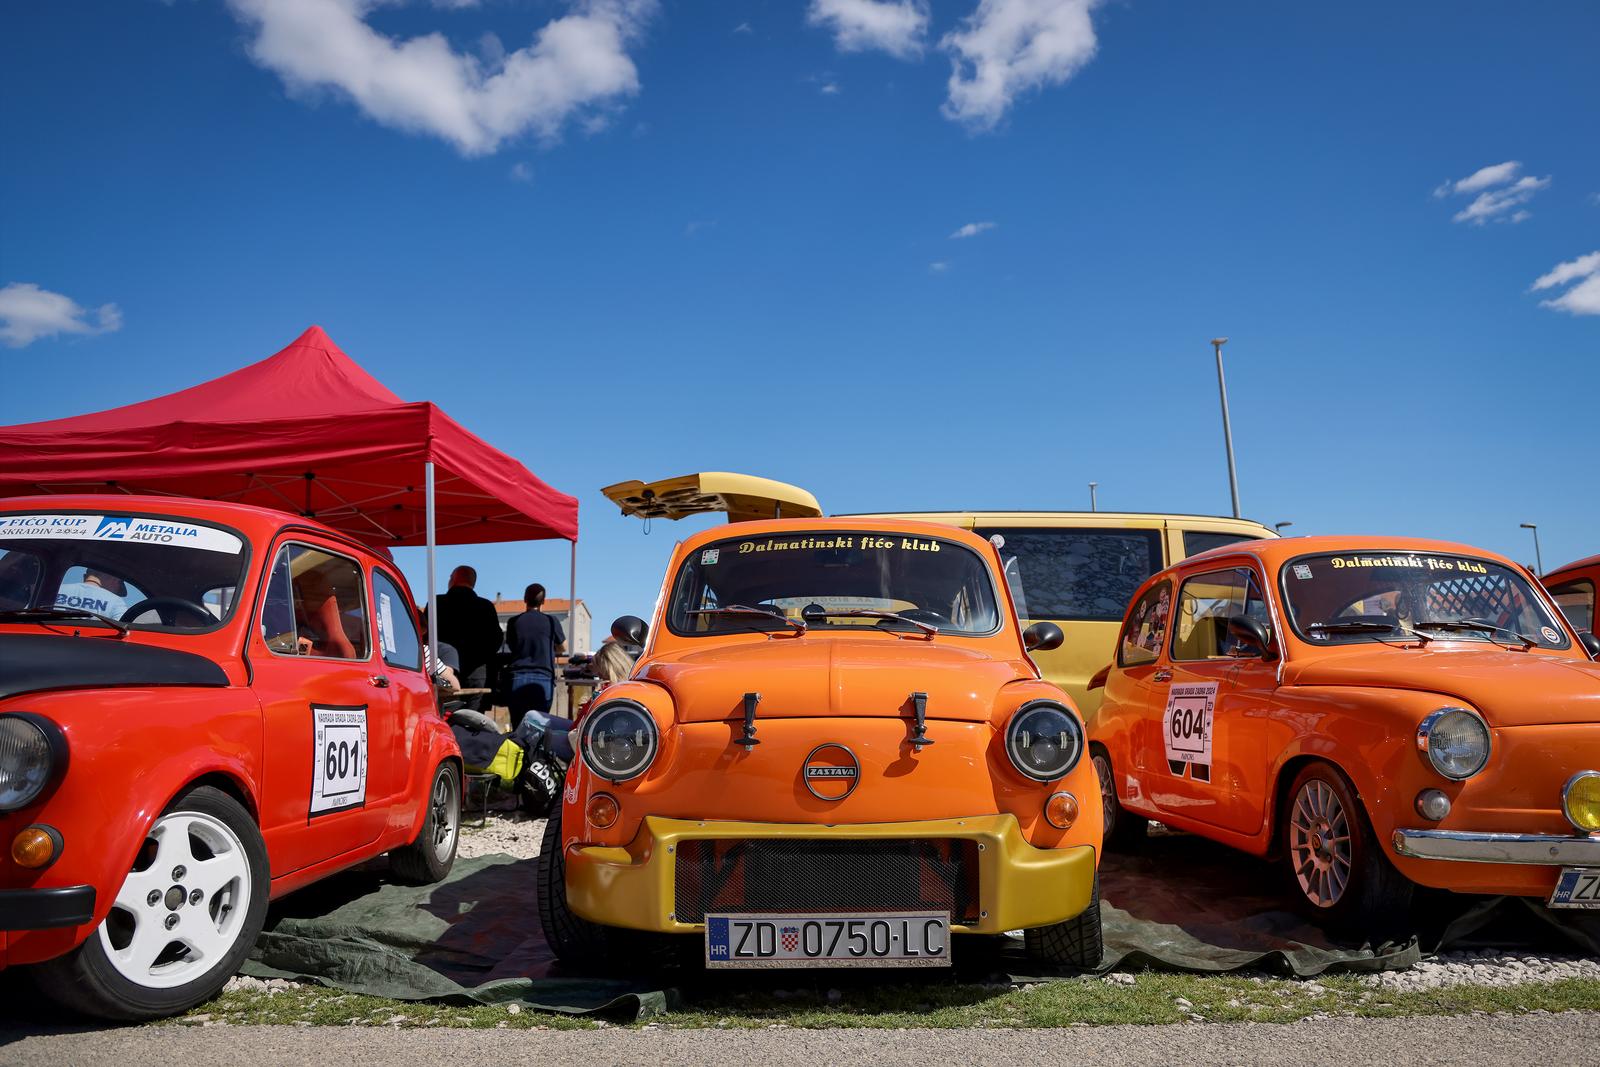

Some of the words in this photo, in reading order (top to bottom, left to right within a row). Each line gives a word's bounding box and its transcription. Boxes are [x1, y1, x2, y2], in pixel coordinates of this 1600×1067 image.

[51, 518, 87, 526] KUP
[135, 523, 198, 537] METALIA
[0, 528, 52, 536] SKRADIN
[55, 528, 87, 536] 2024
[130, 532, 173, 543] AUTO
[738, 536, 853, 554] Dalmatinski
[901, 538, 940, 552] klub
[1331, 555, 1423, 569] Dalmatinski
[1456, 560, 1488, 574] klub
[56, 593, 109, 612] BORN
[1172, 708, 1204, 740] 604
[326, 740, 359, 781] 601
[1556, 890, 1571, 898] HR
[710, 944, 727, 956] HR
[733, 922, 777, 957] ZD
